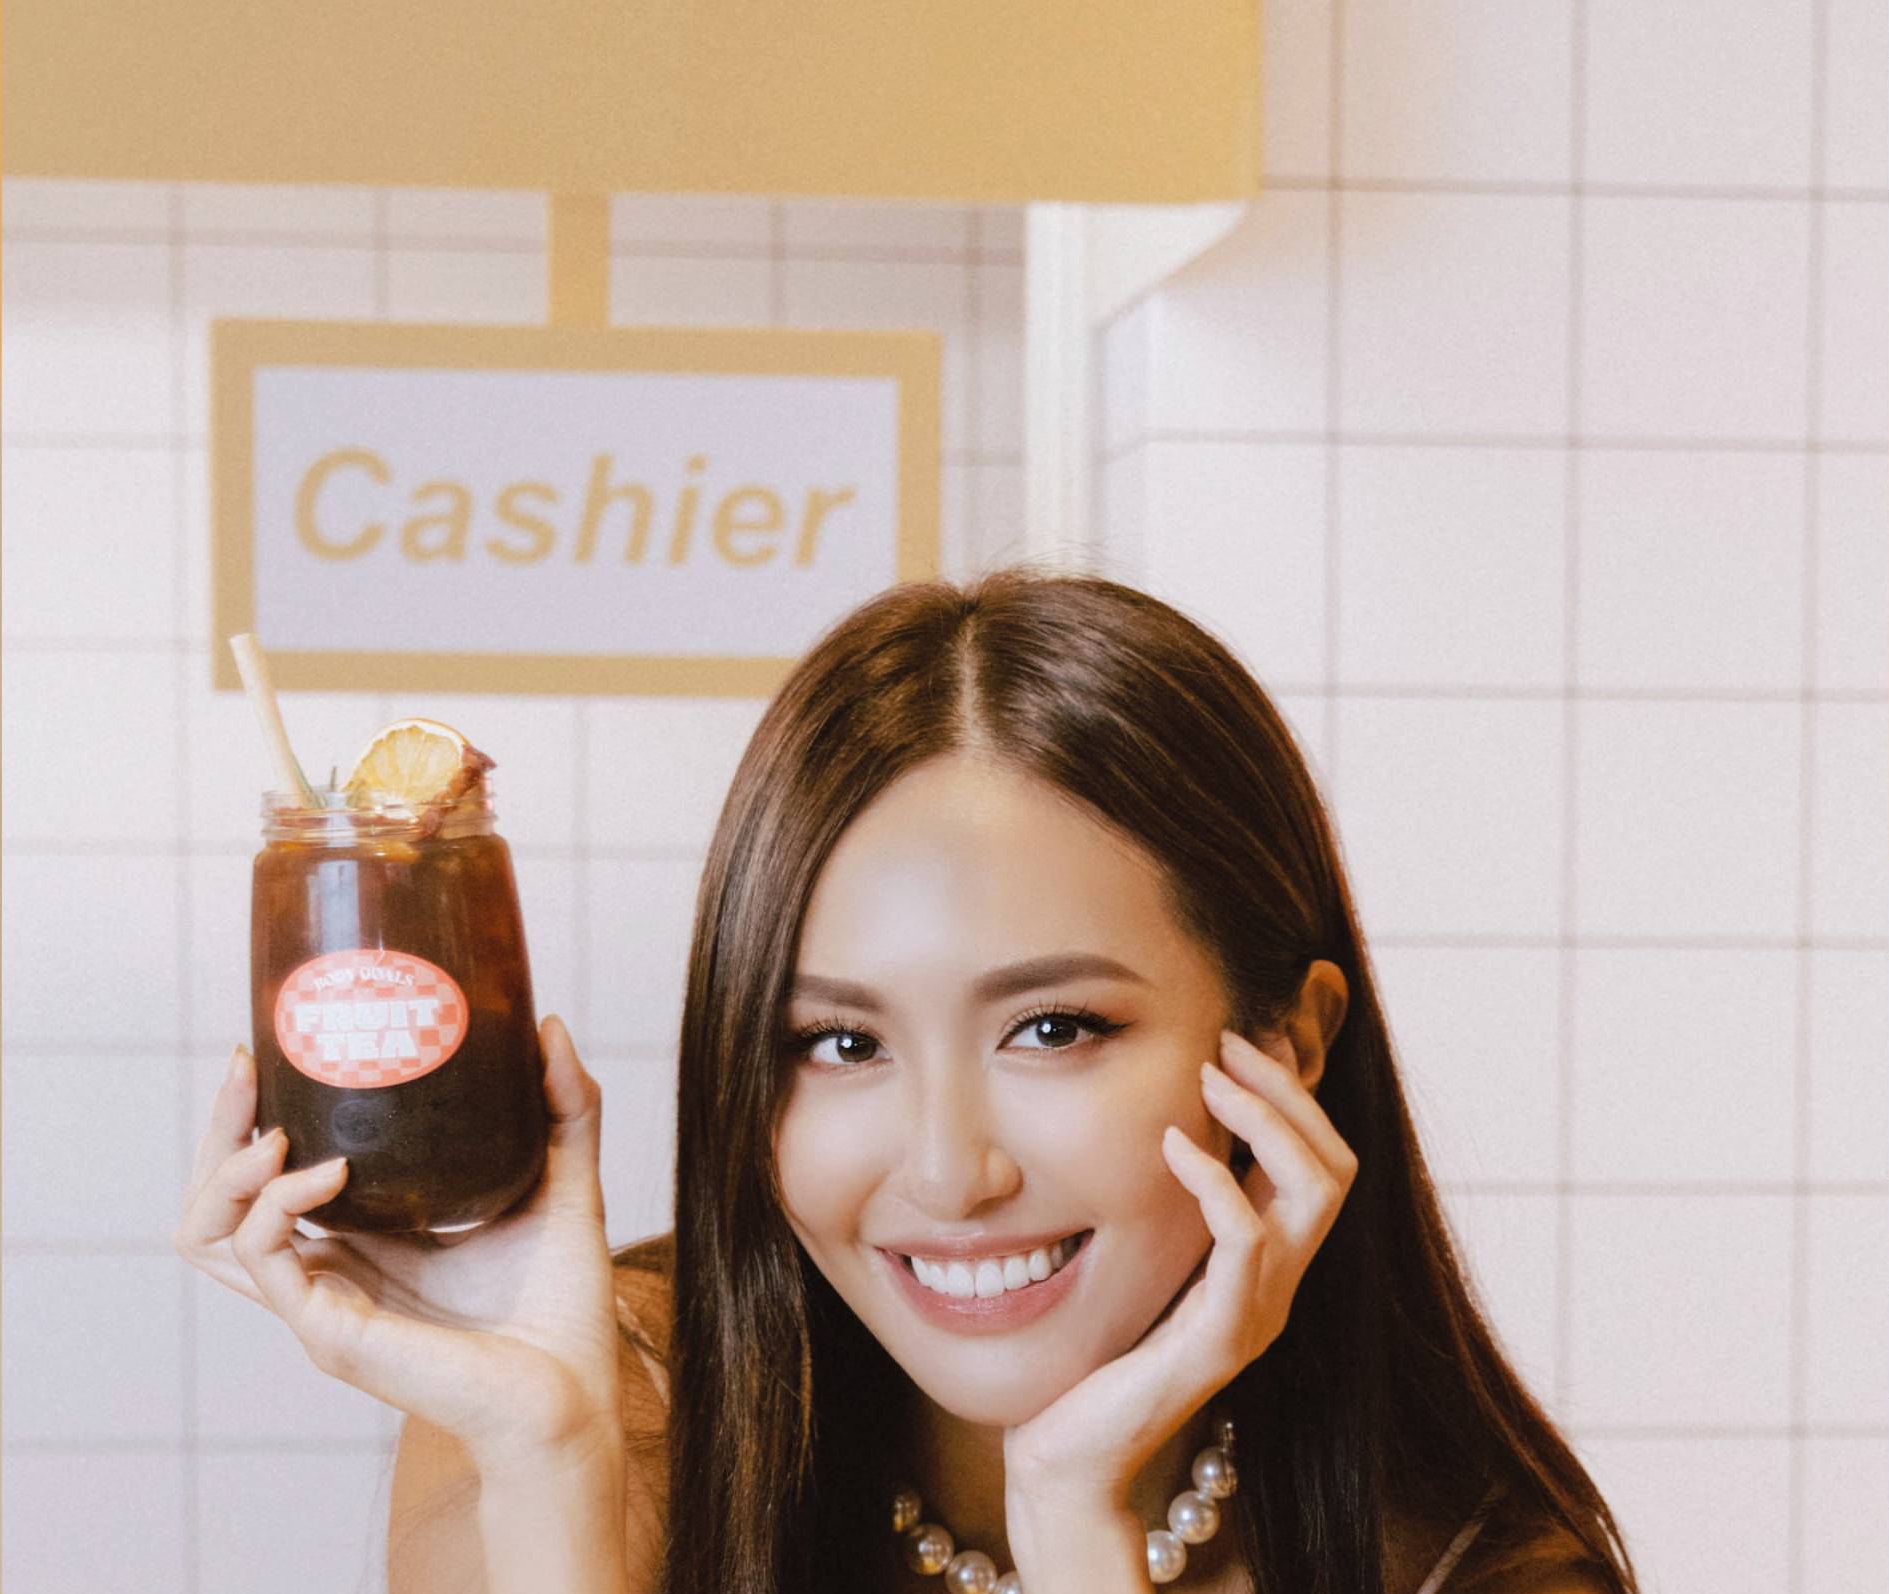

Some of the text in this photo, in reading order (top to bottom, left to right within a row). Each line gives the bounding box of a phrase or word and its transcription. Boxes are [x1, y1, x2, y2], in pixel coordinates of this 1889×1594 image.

[293, 446, 858, 567] Cashier
[313, 967, 416, 991] BODY GOALS
[294, 999, 440, 1032] FRUIT
[315, 1030, 419, 1061] TEA
